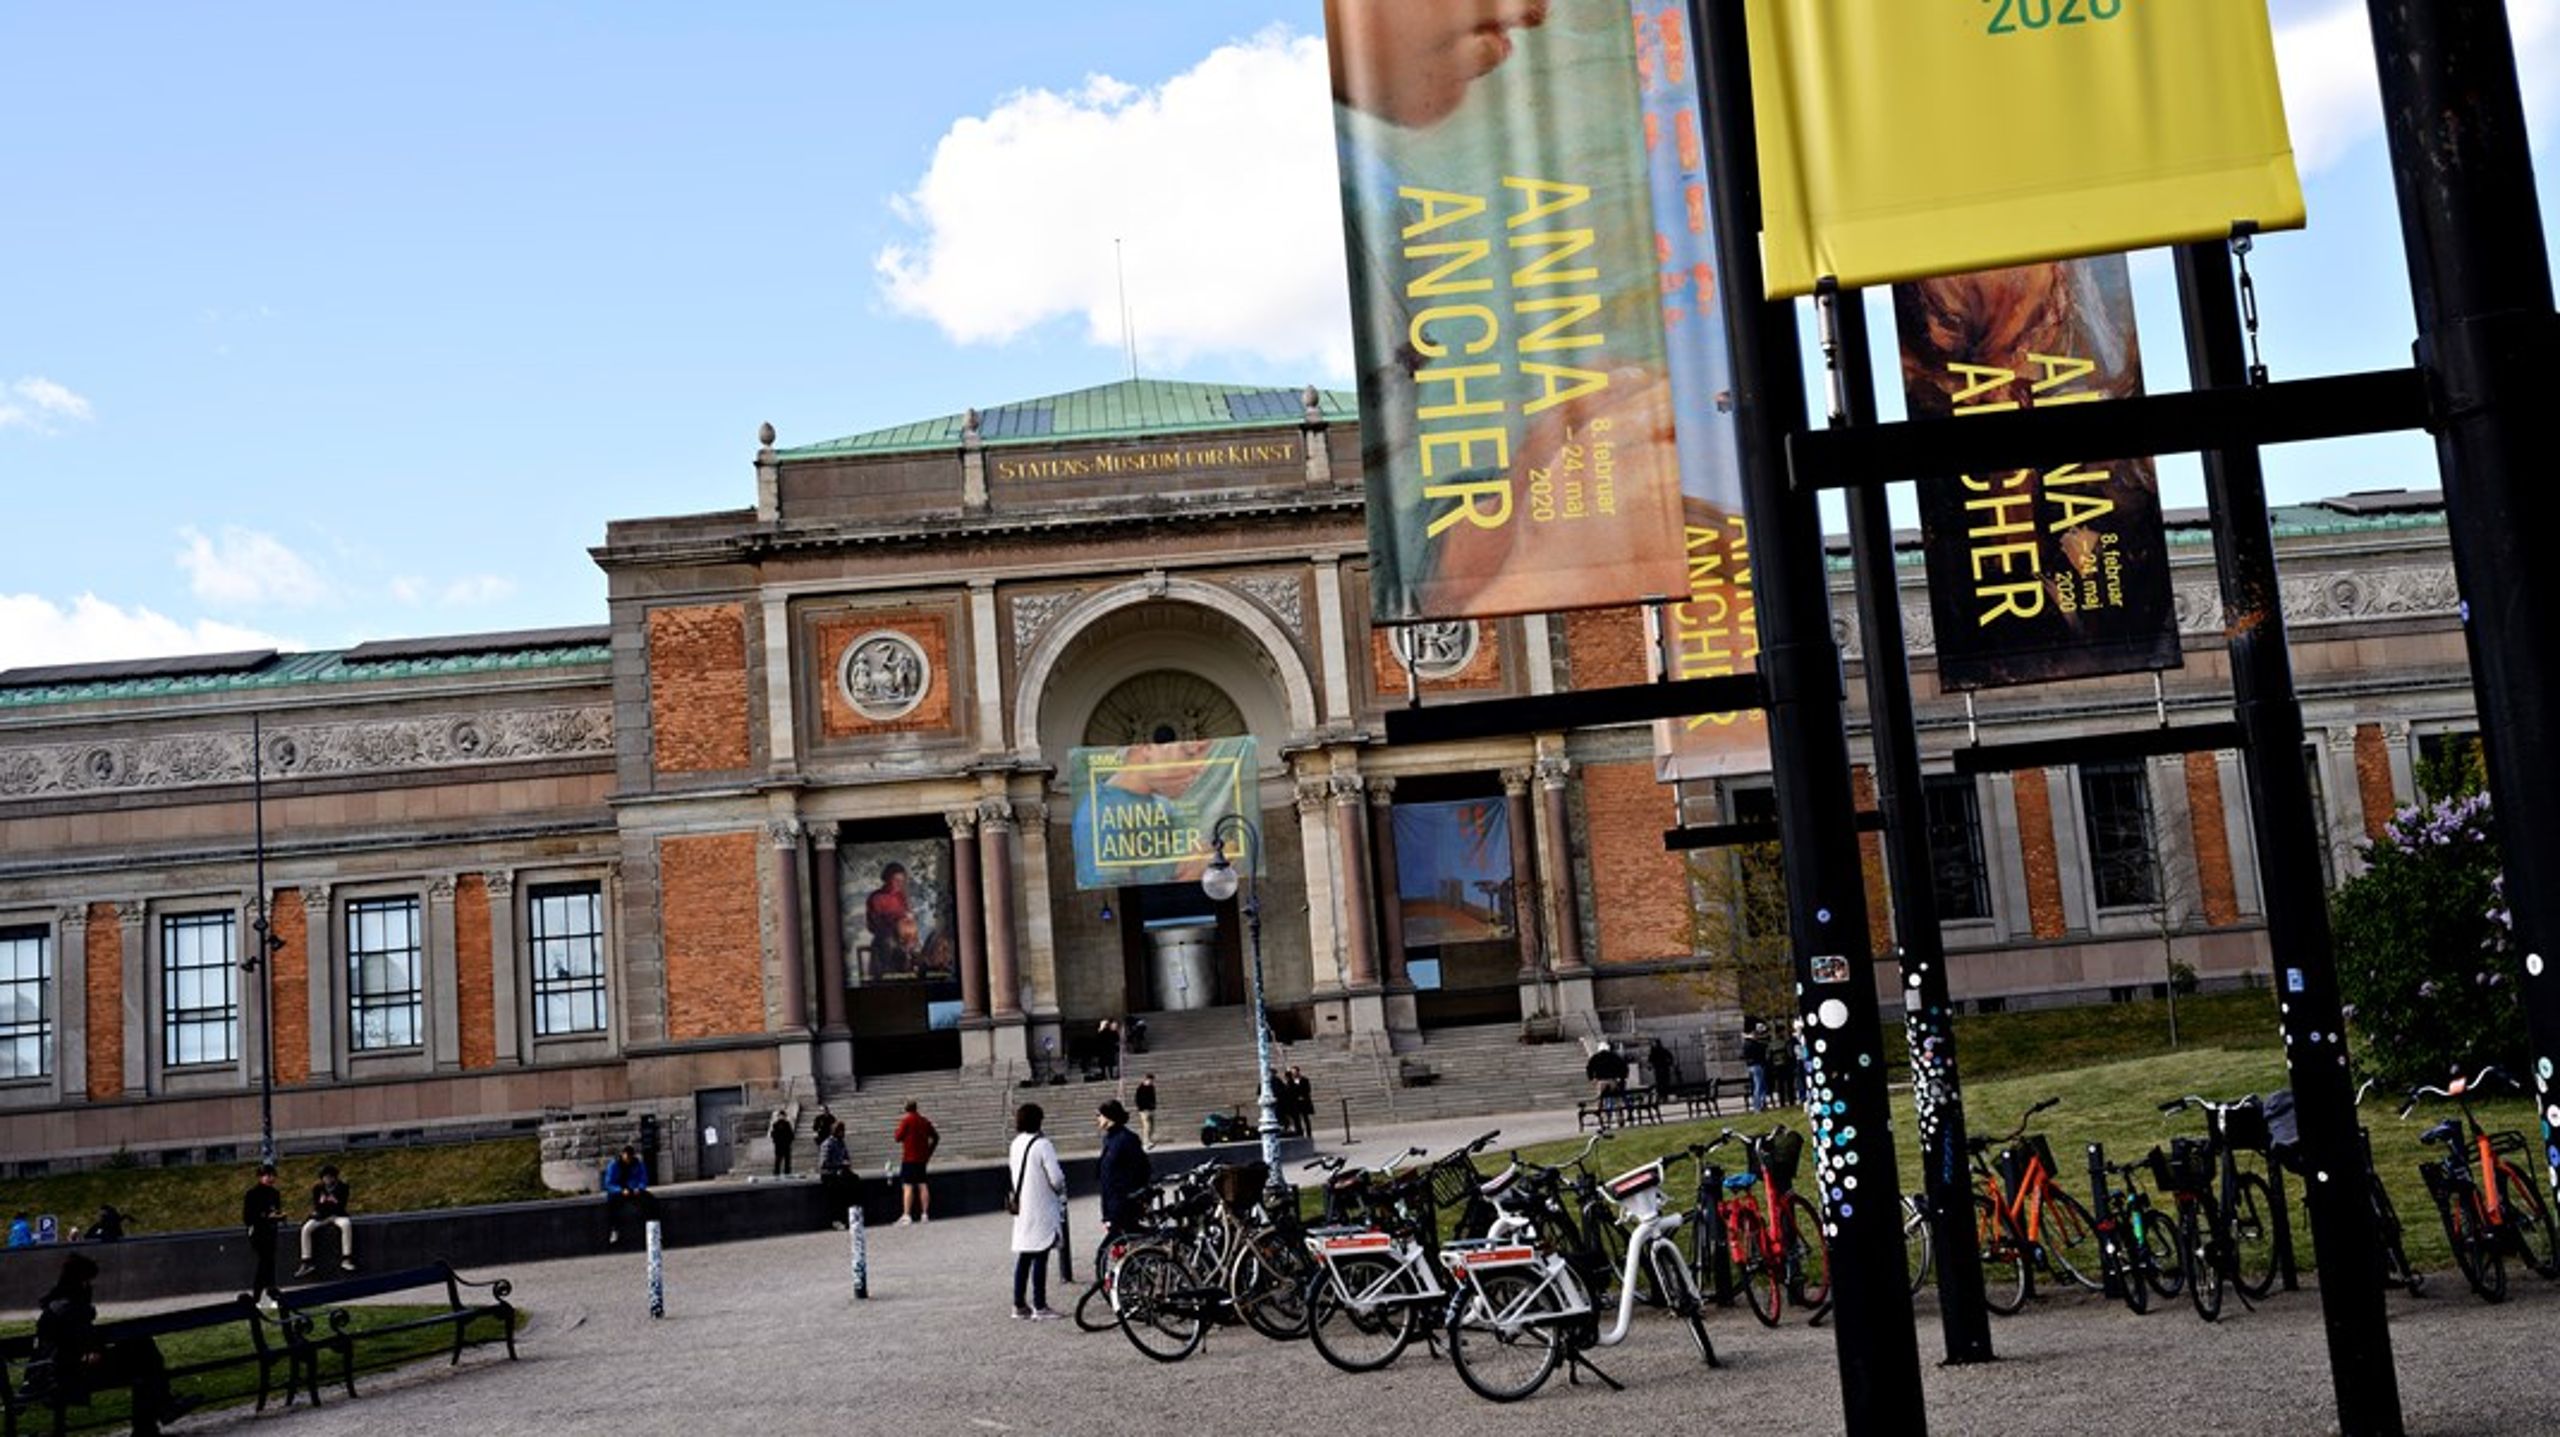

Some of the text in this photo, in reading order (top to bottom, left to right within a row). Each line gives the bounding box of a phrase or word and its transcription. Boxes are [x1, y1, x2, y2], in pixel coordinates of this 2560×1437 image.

[1503, 175, 1609, 416] ANNA
[1398, 186, 1514, 539] ANCHER
[2027, 352, 2115, 533] ANA
[1529, 467, 1556, 522] 2020
[1562, 481, 1590, 518] maj
[1593, 441, 1617, 517] februar
[1947, 362, 2045, 627] AHER
[2055, 571, 2078, 613] 2020
[2082, 580, 2104, 611] maj
[2104, 551, 2124, 608] februar
[1674, 525, 1740, 731] ANCH
[1101, 802, 1170, 831] ANNA
[1102, 828, 1204, 859] ANCHER
